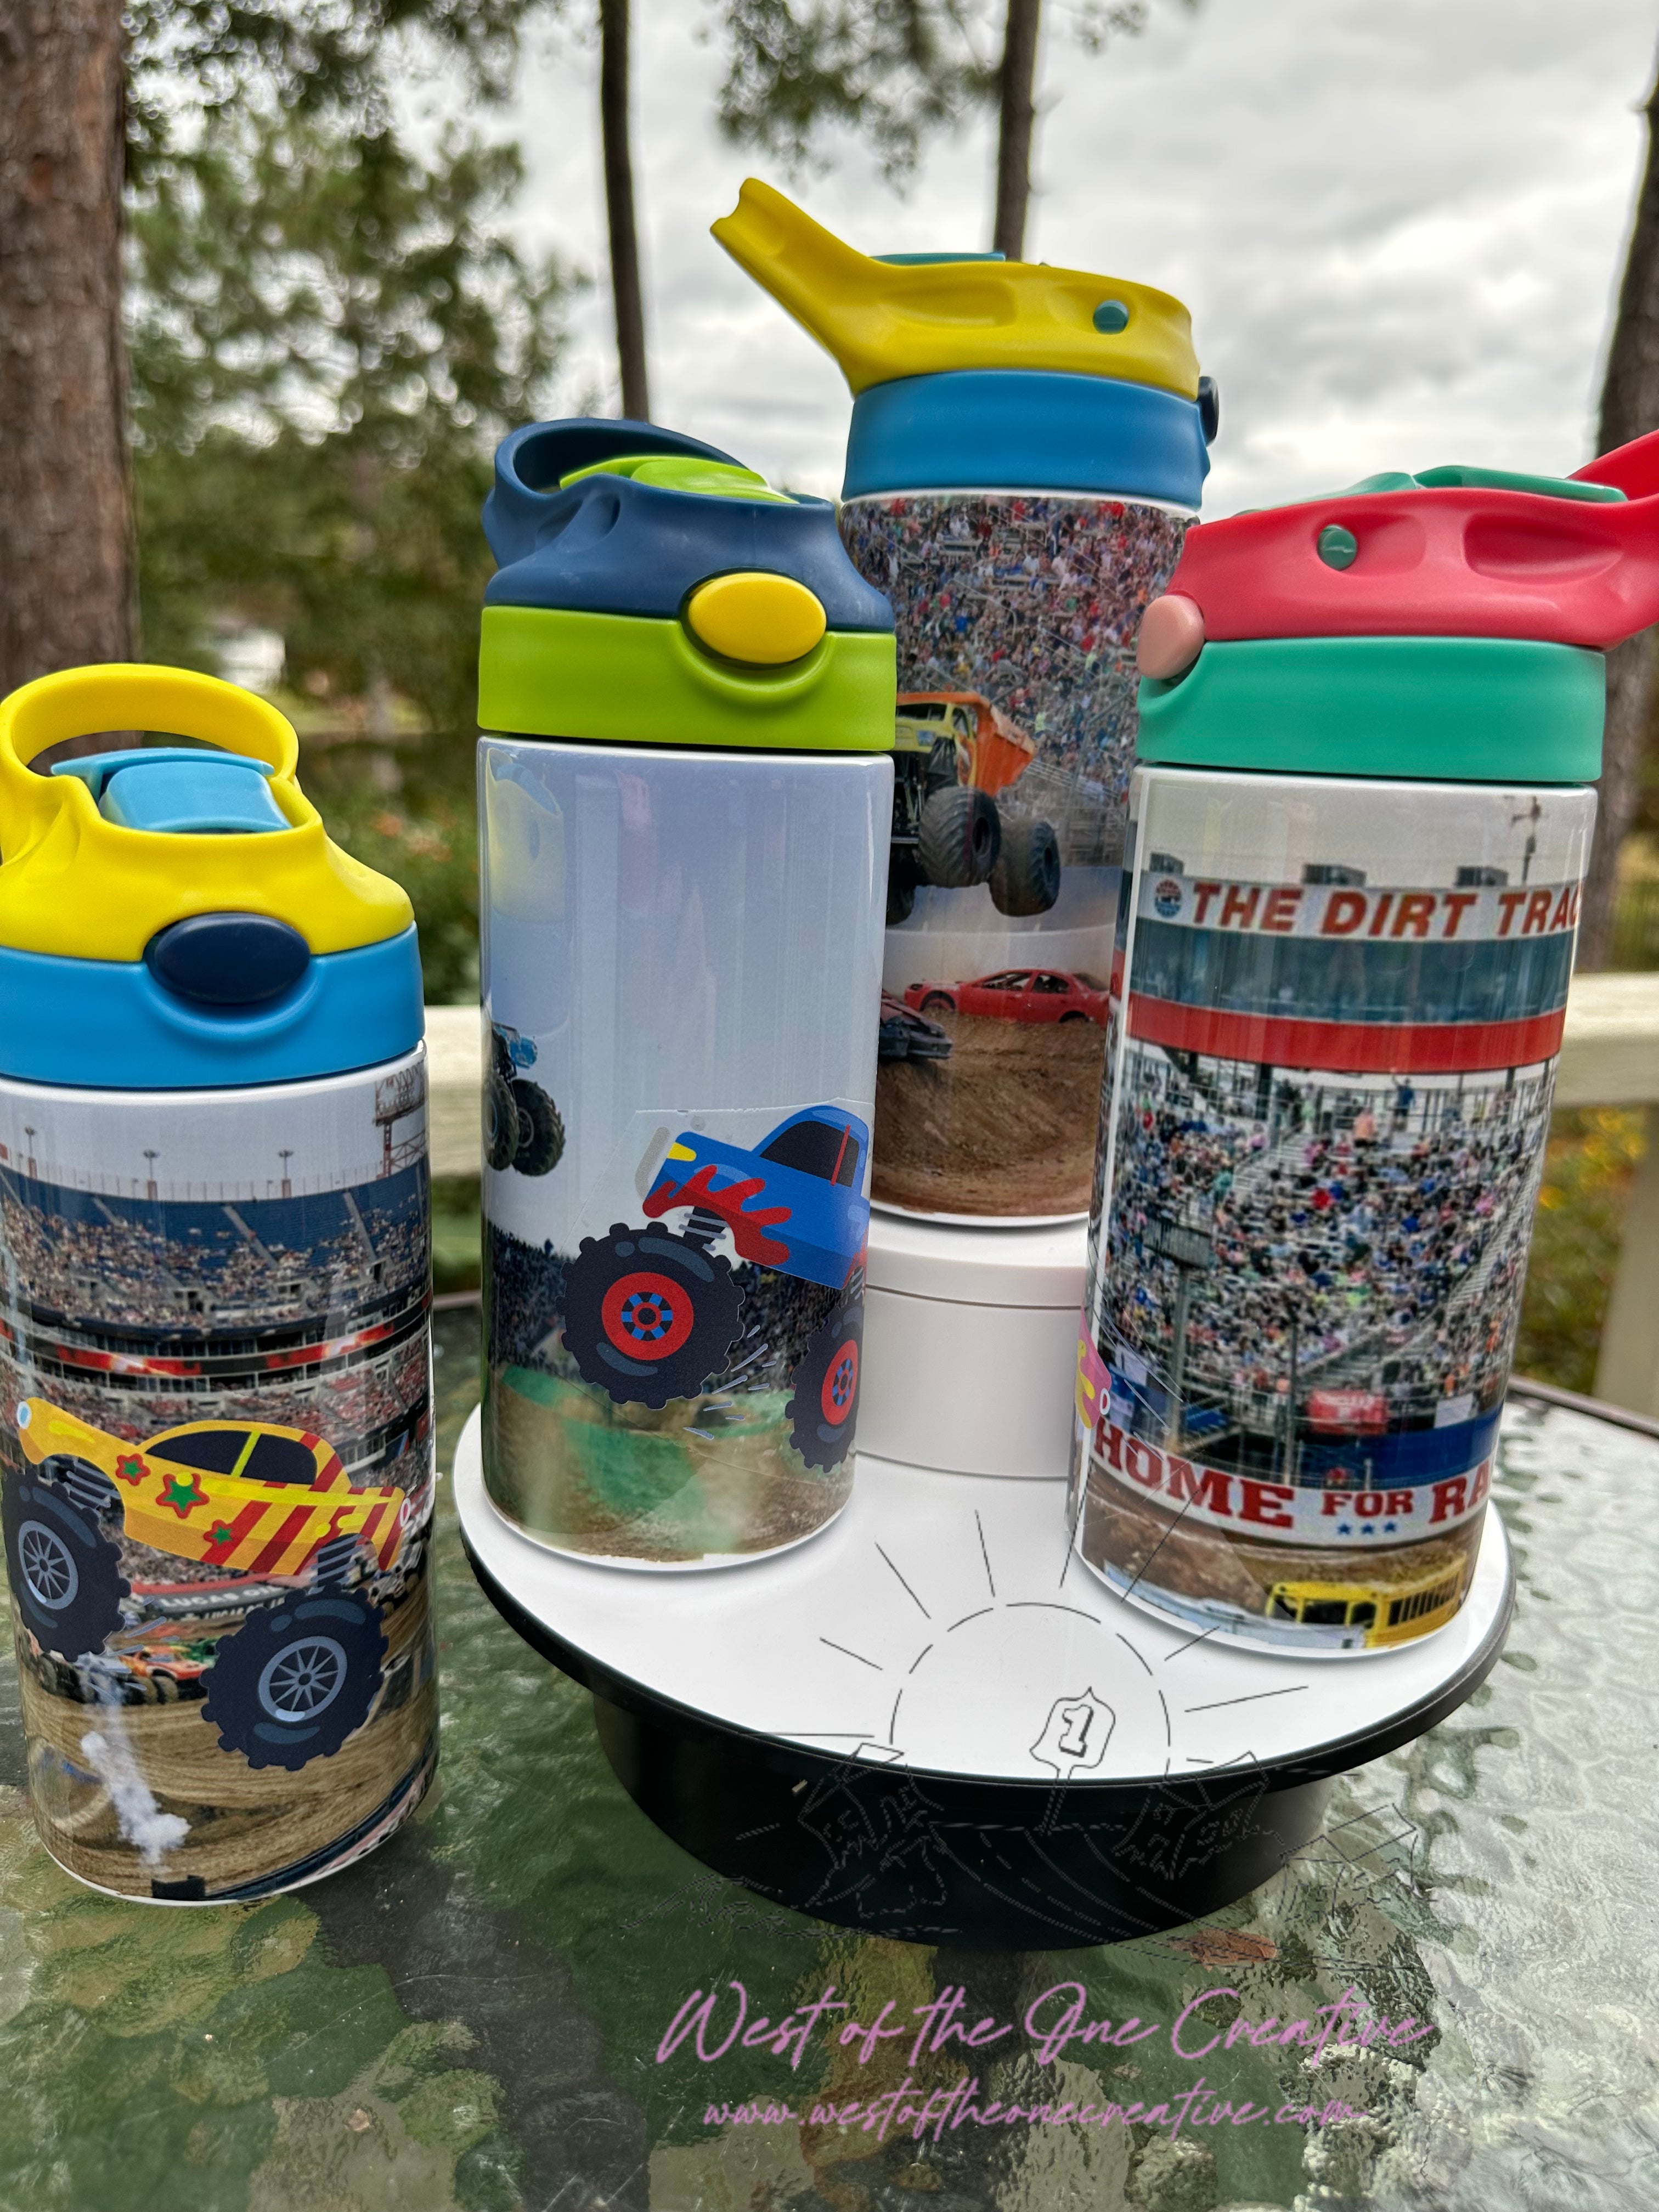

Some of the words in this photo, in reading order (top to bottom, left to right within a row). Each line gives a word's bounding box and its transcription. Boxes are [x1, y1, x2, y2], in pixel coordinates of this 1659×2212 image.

[1193, 881, 1304, 932] THE
[1321, 890, 1474, 938] DIRT
[1094, 1414, 1295, 1529] HOME
[1321, 1489, 1414, 1518] FOR
